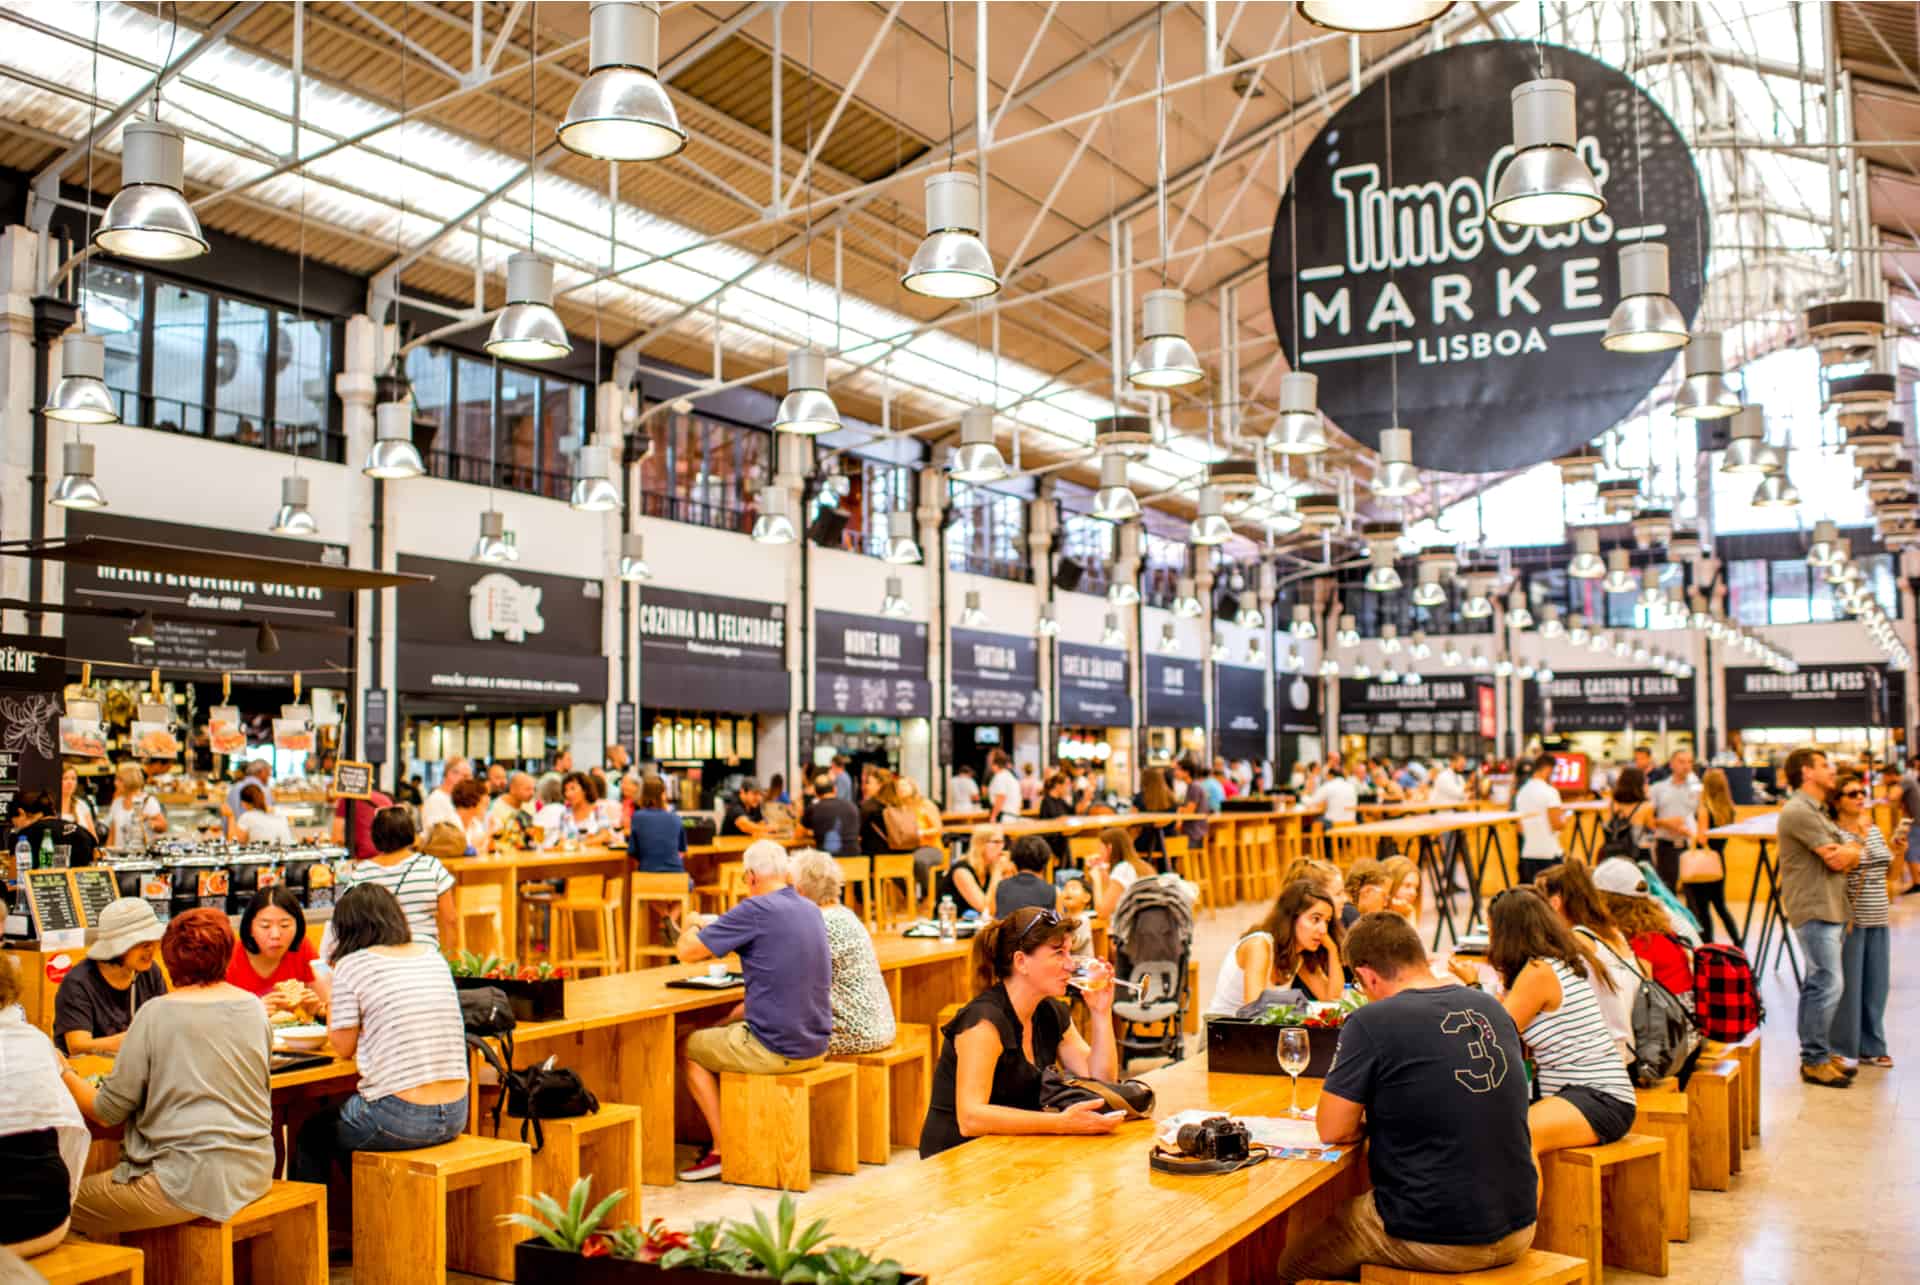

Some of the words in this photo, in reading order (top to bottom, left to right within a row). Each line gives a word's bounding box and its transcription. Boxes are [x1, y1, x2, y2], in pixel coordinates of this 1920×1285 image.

[1303, 256, 1602, 339] MARKE
[1418, 327, 1548, 364] LISBOA
[639, 604, 696, 638] COZINHA
[698, 611, 716, 640] DA
[1440, 1008, 1509, 1093] 3
